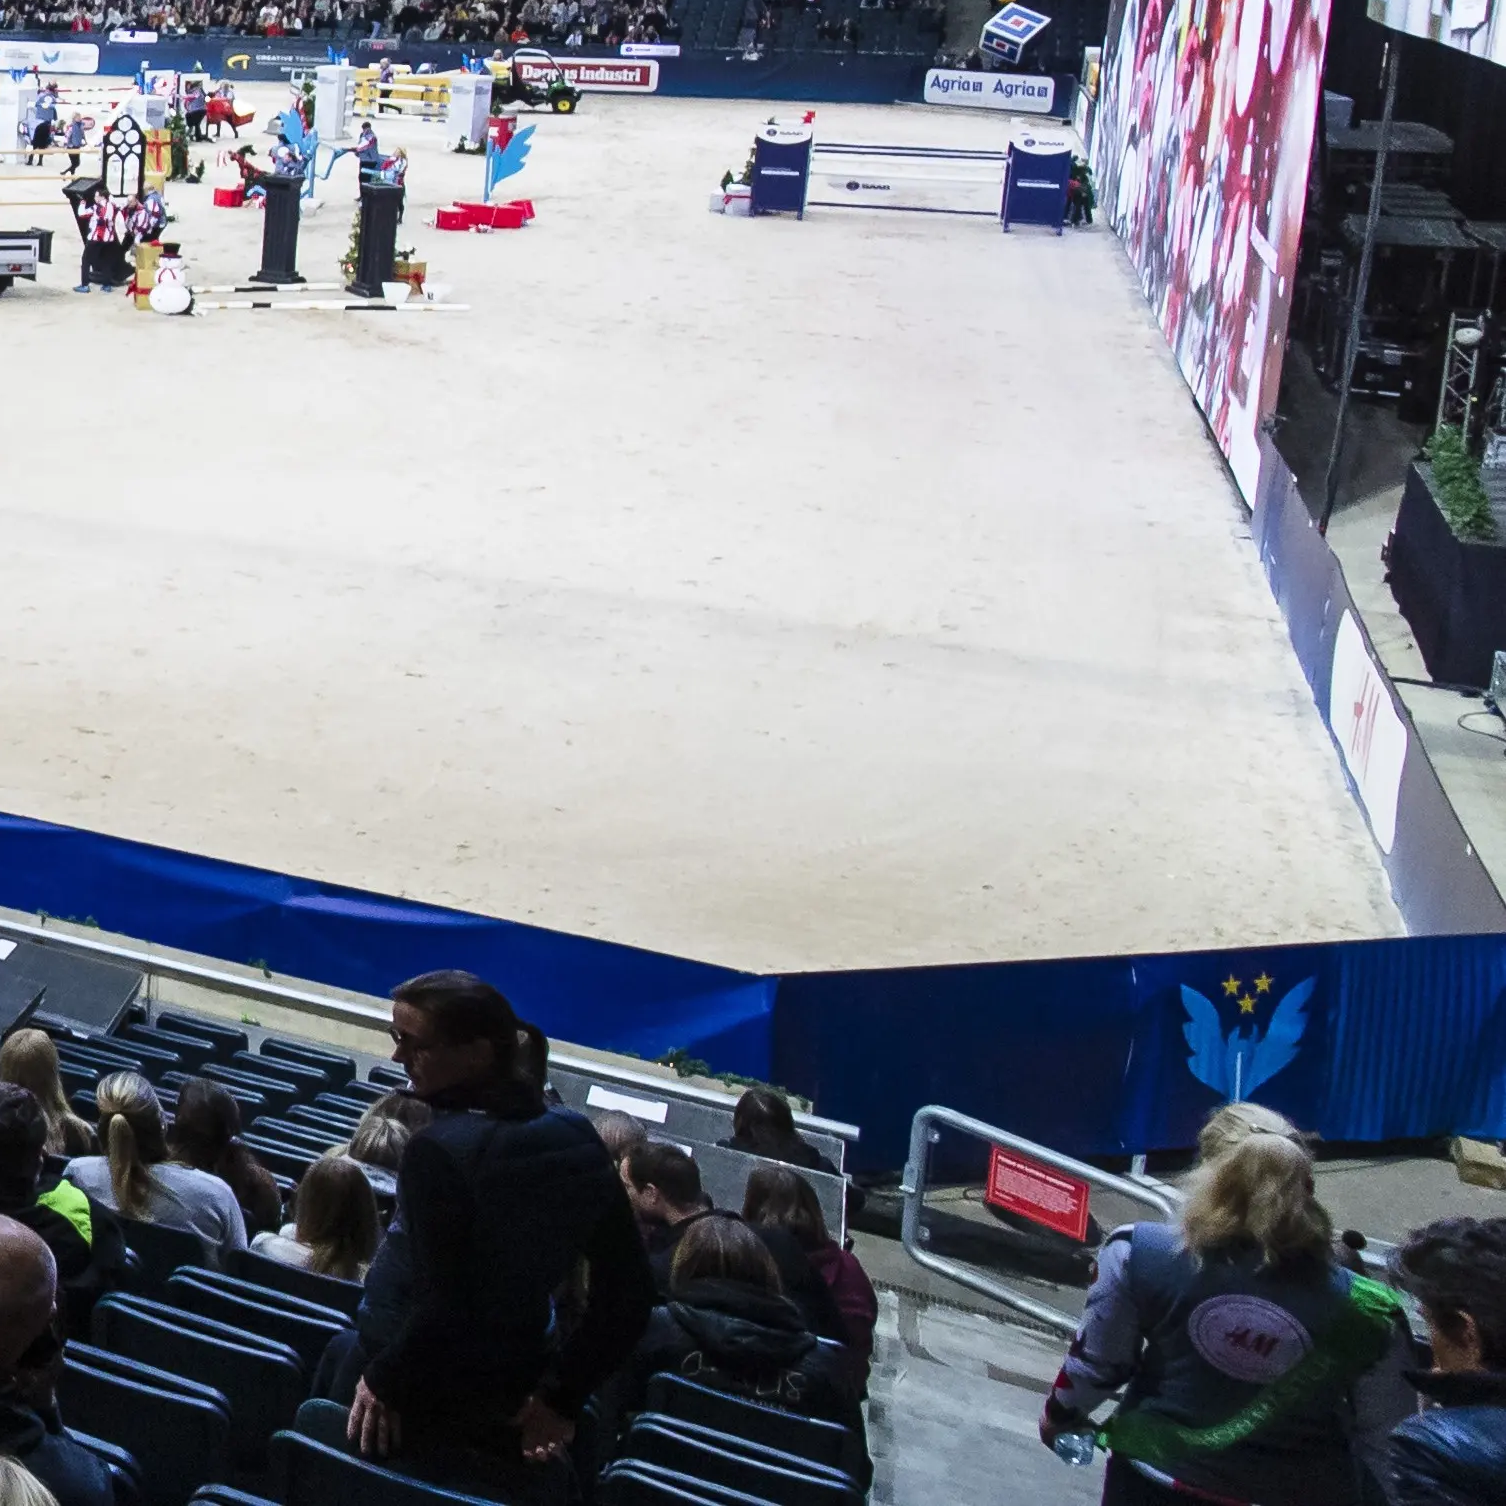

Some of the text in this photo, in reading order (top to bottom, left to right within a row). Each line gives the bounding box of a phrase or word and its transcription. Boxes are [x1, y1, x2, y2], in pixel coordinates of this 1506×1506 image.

[580, 66, 641, 82] industri
[931, 74, 971, 93] Agria
[992, 79, 1035, 98] Agria
